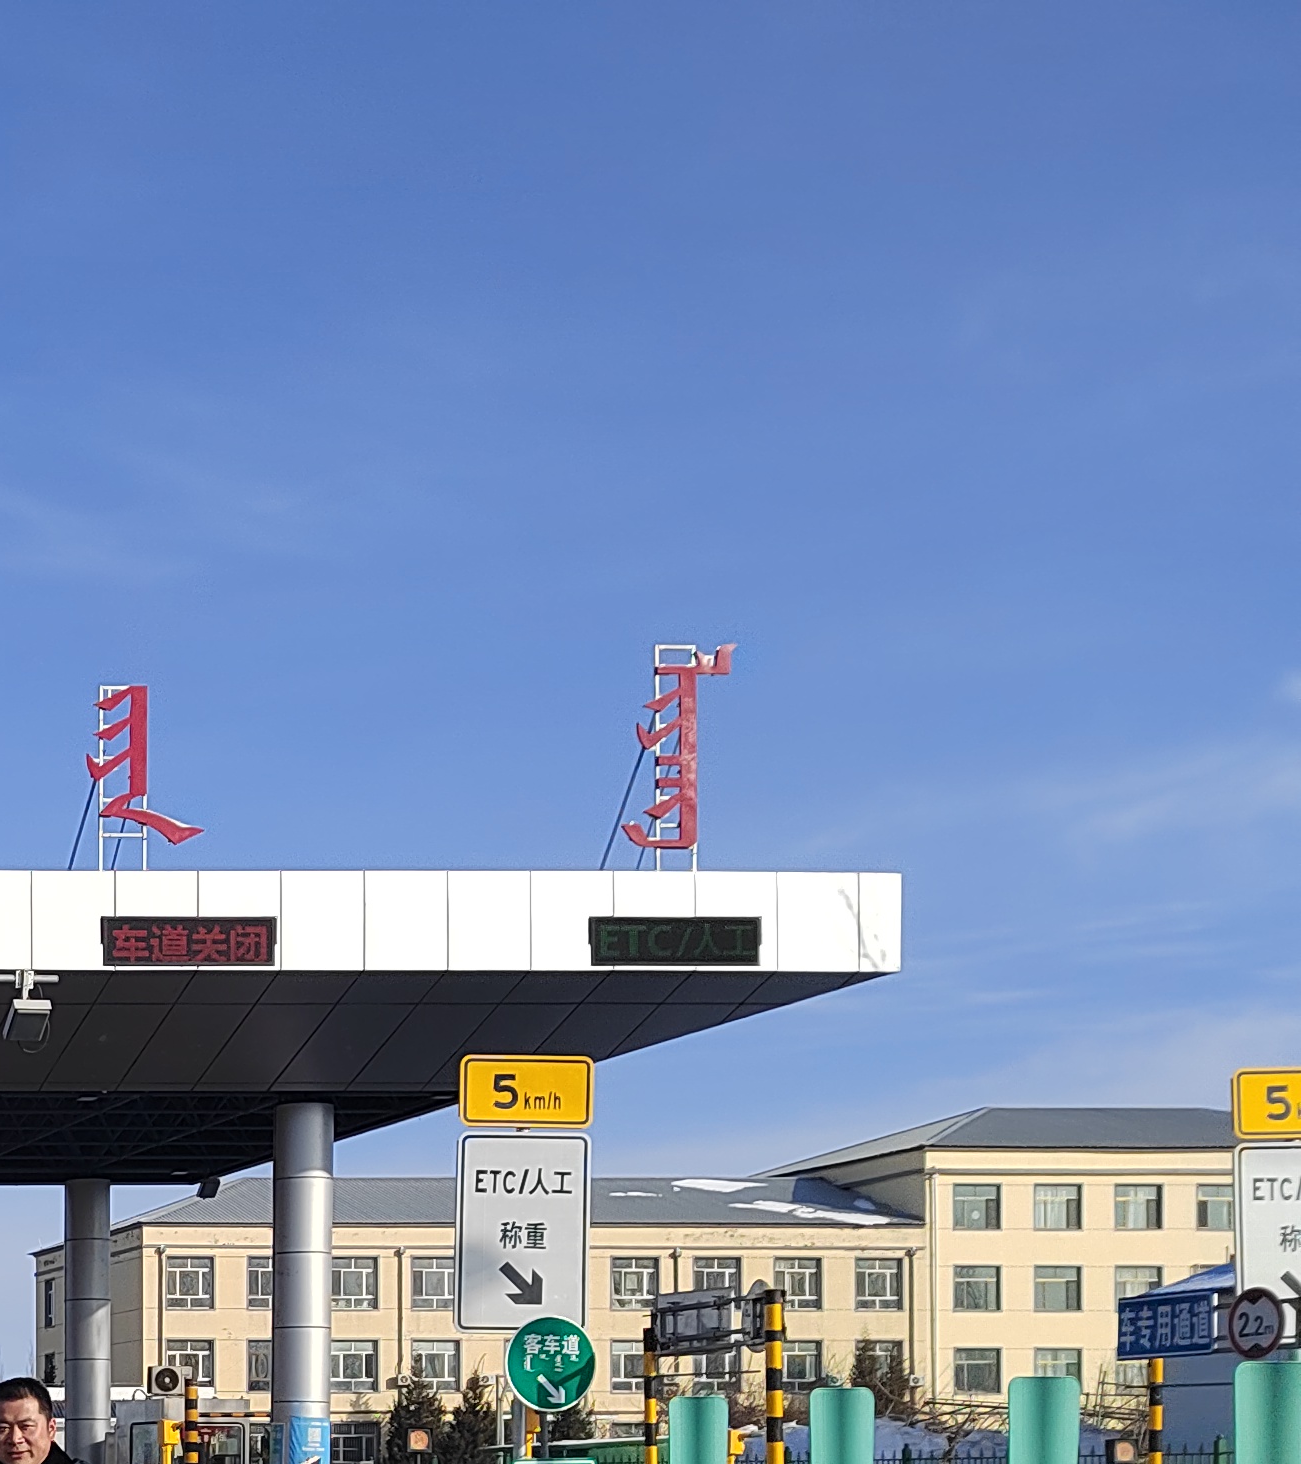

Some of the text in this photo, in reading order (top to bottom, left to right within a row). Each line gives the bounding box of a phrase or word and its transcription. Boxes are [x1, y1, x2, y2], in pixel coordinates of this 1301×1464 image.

[112, 924, 268, 962] 车道关闭
[493, 1074, 561, 1110] 5 km/h
[1266, 1085, 1291, 1121] 5
[474, 1168, 573, 1195] ETC/人工
[499, 1221, 547, 1250] 称重
[523, 1333, 580, 1355] 客车道
